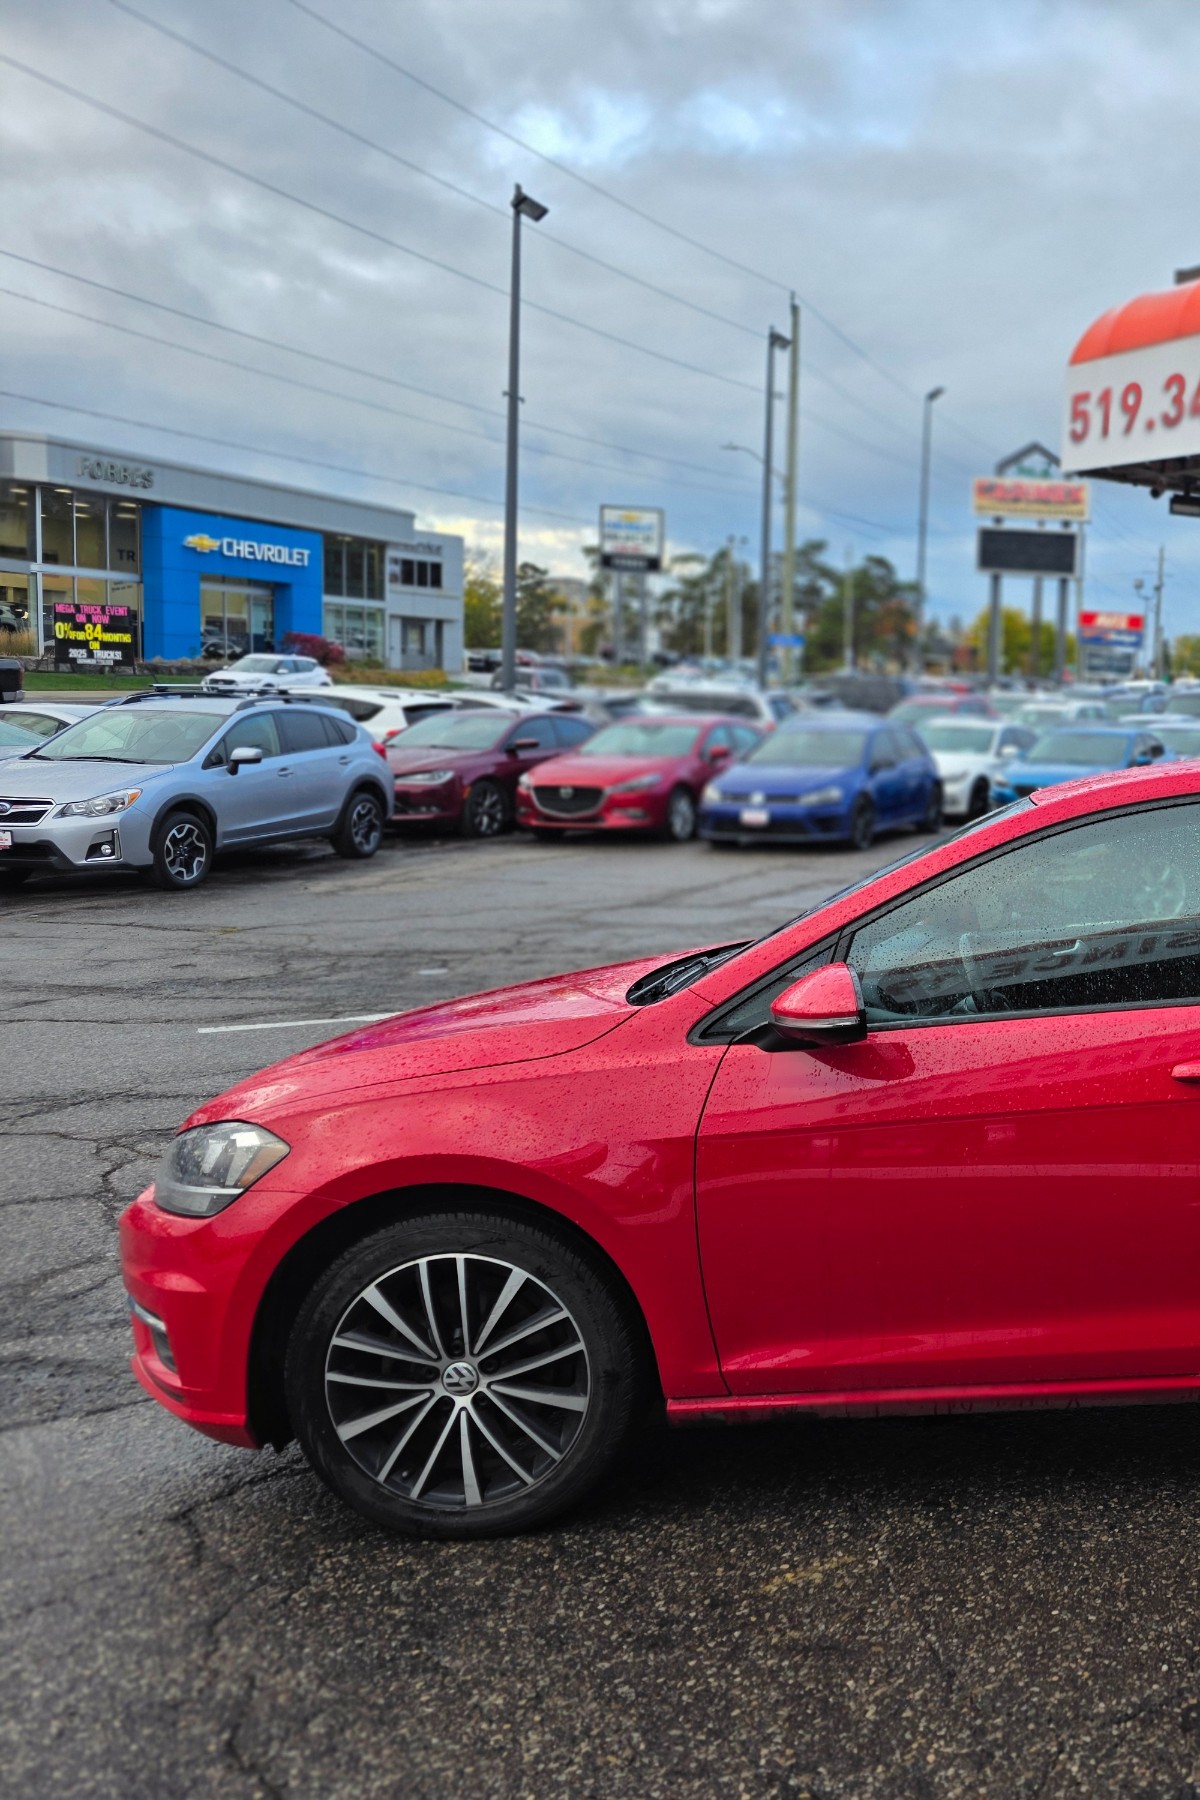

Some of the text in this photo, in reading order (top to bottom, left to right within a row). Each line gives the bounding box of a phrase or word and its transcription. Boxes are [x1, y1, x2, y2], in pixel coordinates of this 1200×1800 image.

[77, 457, 154, 489] FORBES
[222, 537, 311, 567] CHEVROLET
[55, 603, 129, 616] MEGA TRUCK EVENT
[75, 614, 110, 624] ON NOW
[89, 641, 100, 650] ON
